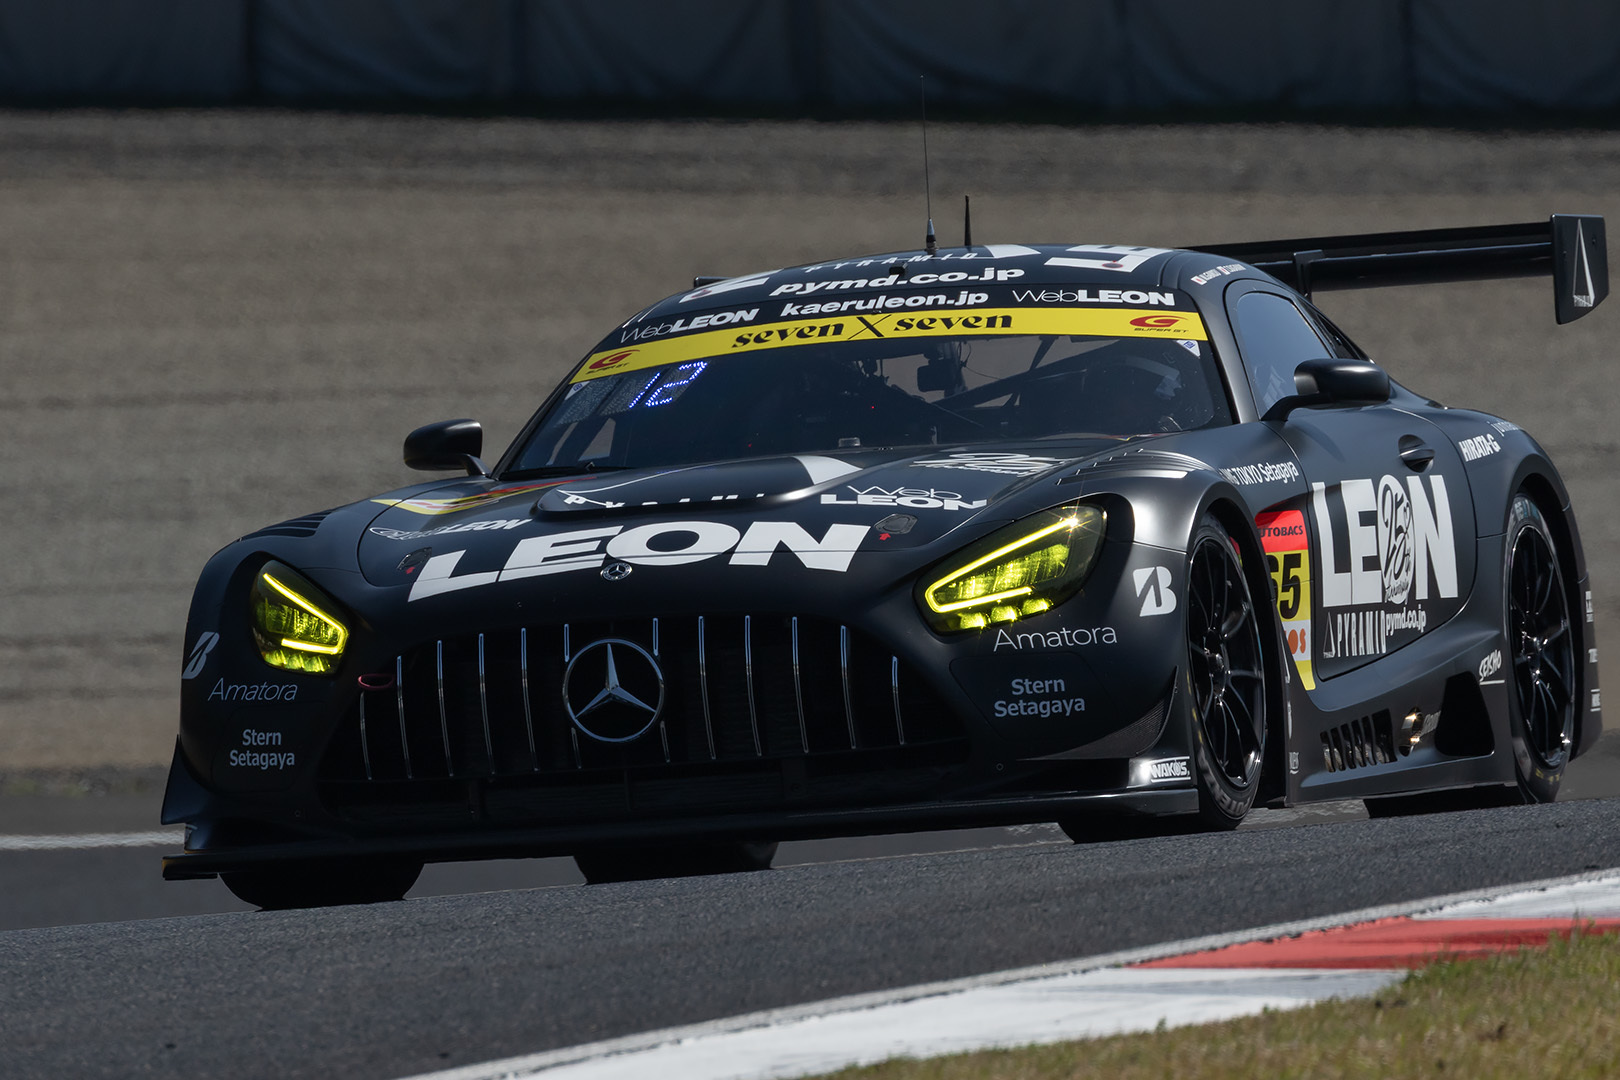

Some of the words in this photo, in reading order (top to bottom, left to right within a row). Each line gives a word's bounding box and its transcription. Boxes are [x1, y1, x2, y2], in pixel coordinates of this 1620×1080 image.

[768, 267, 1025, 297] pymd.co.jp
[780, 290, 989, 318] kaeruleon.jp
[1012, 288, 1175, 306] WebLEON
[620, 308, 760, 344] WebLEON
[732, 322, 845, 349] seven
[893, 314, 1013, 332] seven
[1258, 461, 1299, 484] Setagaya
[820, 494, 987, 511] LEON
[847, 485, 962, 501] Web
[1312, 474, 1459, 608] LEON
[408, 521, 871, 603] LEON
[994, 626, 1117, 652] Amatora
[207, 677, 298, 701] Amatora
[1011, 678, 1065, 695] Stern
[994, 697, 1086, 718] Setagaya
[242, 729, 282, 746] Stern
[229, 750, 295, 770] Setagaya
